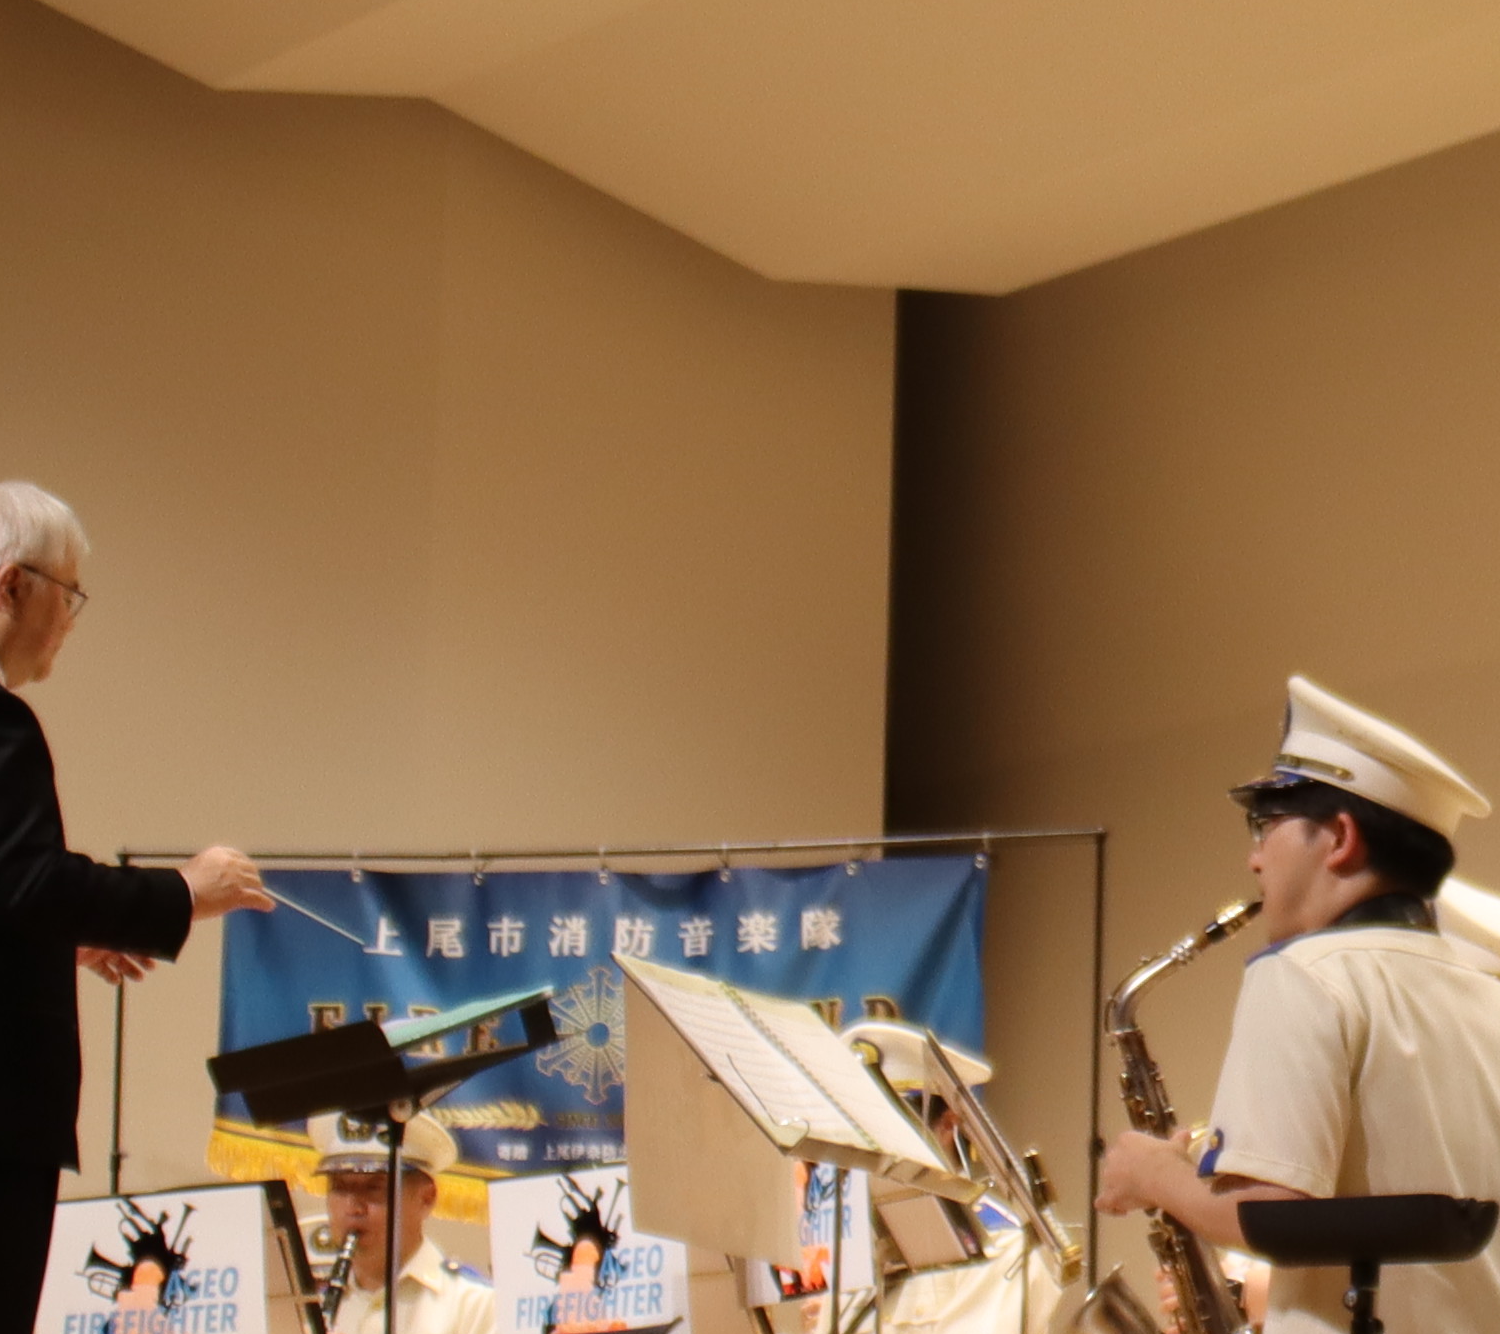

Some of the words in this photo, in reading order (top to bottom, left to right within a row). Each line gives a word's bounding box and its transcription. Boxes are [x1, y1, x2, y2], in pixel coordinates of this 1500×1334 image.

[363, 910, 842, 960] 上尾市消防音楽隊
[598, 1244, 664, 1281] AGEO
[163, 1267, 240, 1305] AGEO
[516, 1283, 664, 1330] FIREFIGHTER
